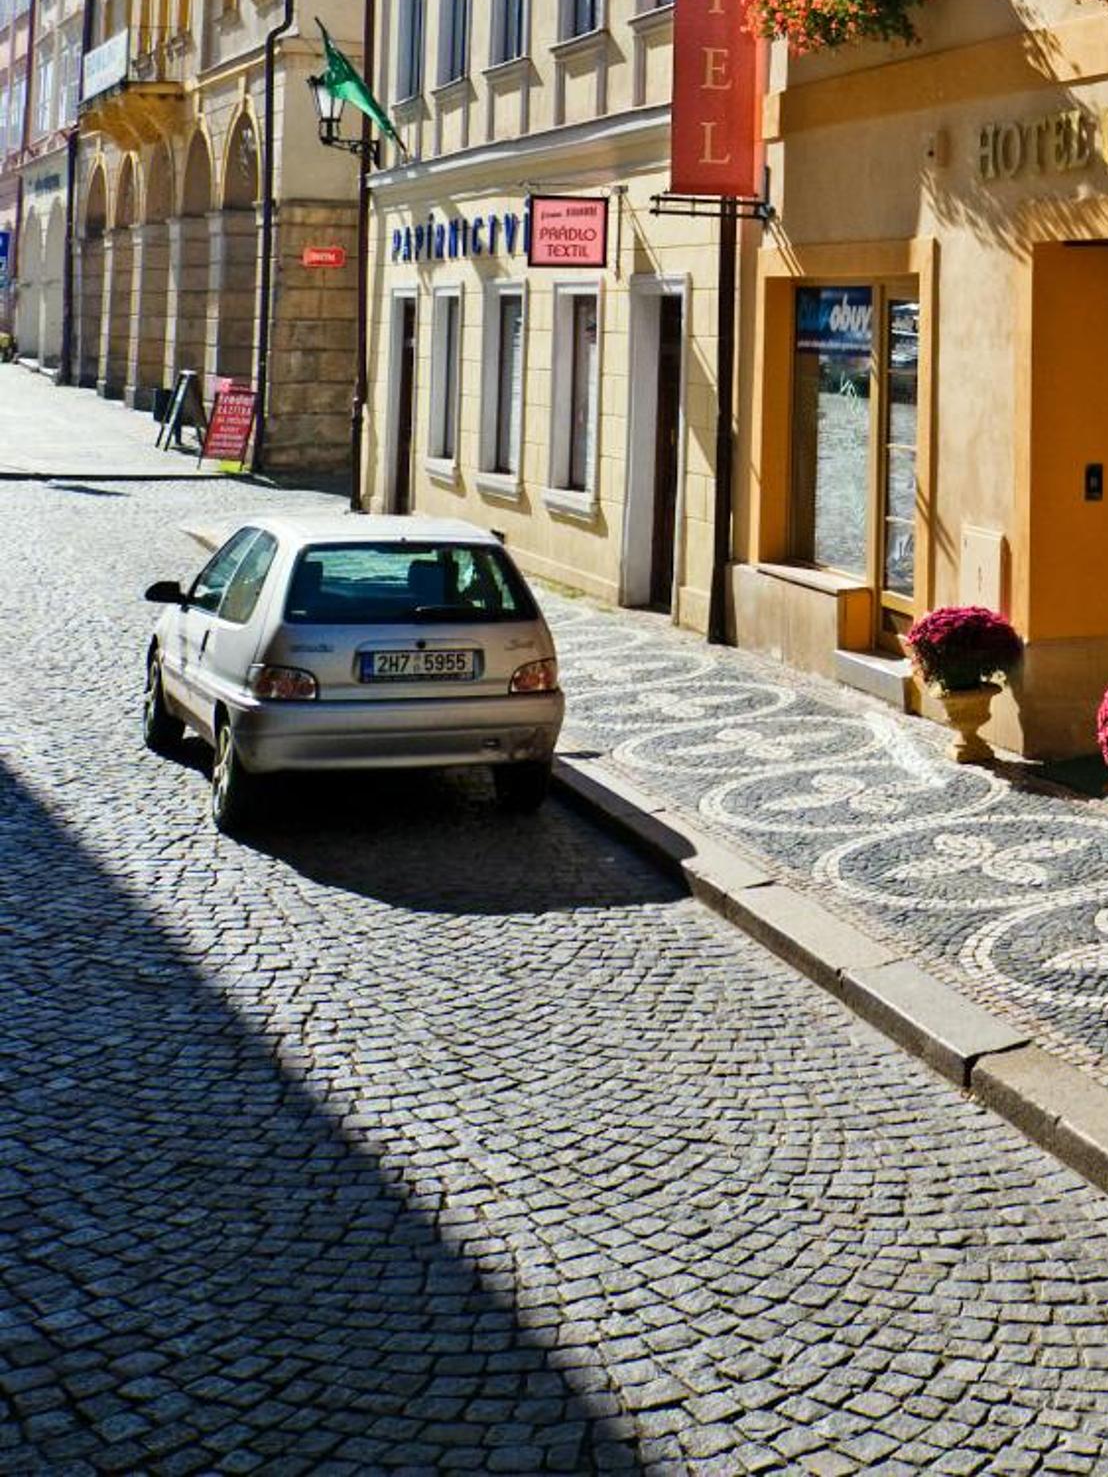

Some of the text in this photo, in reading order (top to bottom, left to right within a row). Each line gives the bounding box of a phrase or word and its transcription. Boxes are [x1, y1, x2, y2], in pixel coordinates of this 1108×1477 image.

[977, 110, 1093, 180] HOTEL
[539, 225, 597, 242] PRÁDLO
[543, 243, 590, 258] TEXTIL
[377, 654, 466, 672] 2H7 5955
